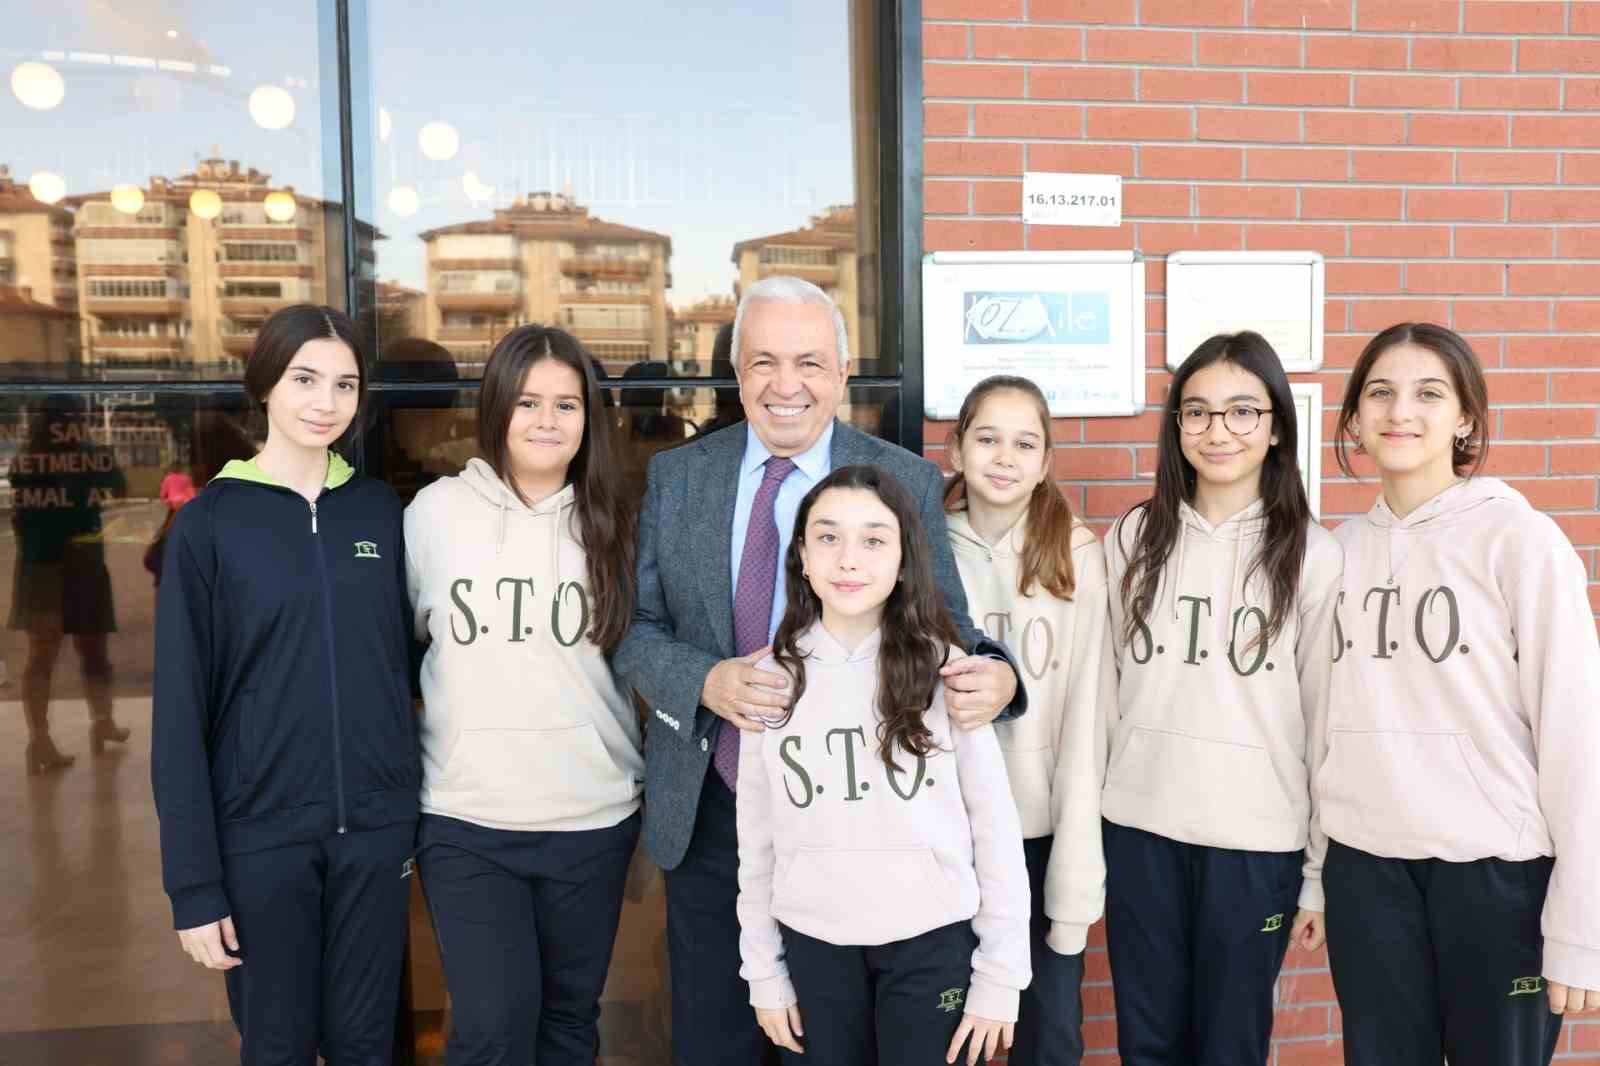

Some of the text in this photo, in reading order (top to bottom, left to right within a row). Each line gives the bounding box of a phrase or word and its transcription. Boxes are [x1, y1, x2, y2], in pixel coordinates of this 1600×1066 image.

[1029, 193, 1116, 207] 16.13.217.01
[450, 576, 596, 647] S.T.O.
[779, 725, 935, 809] S.T.O.
